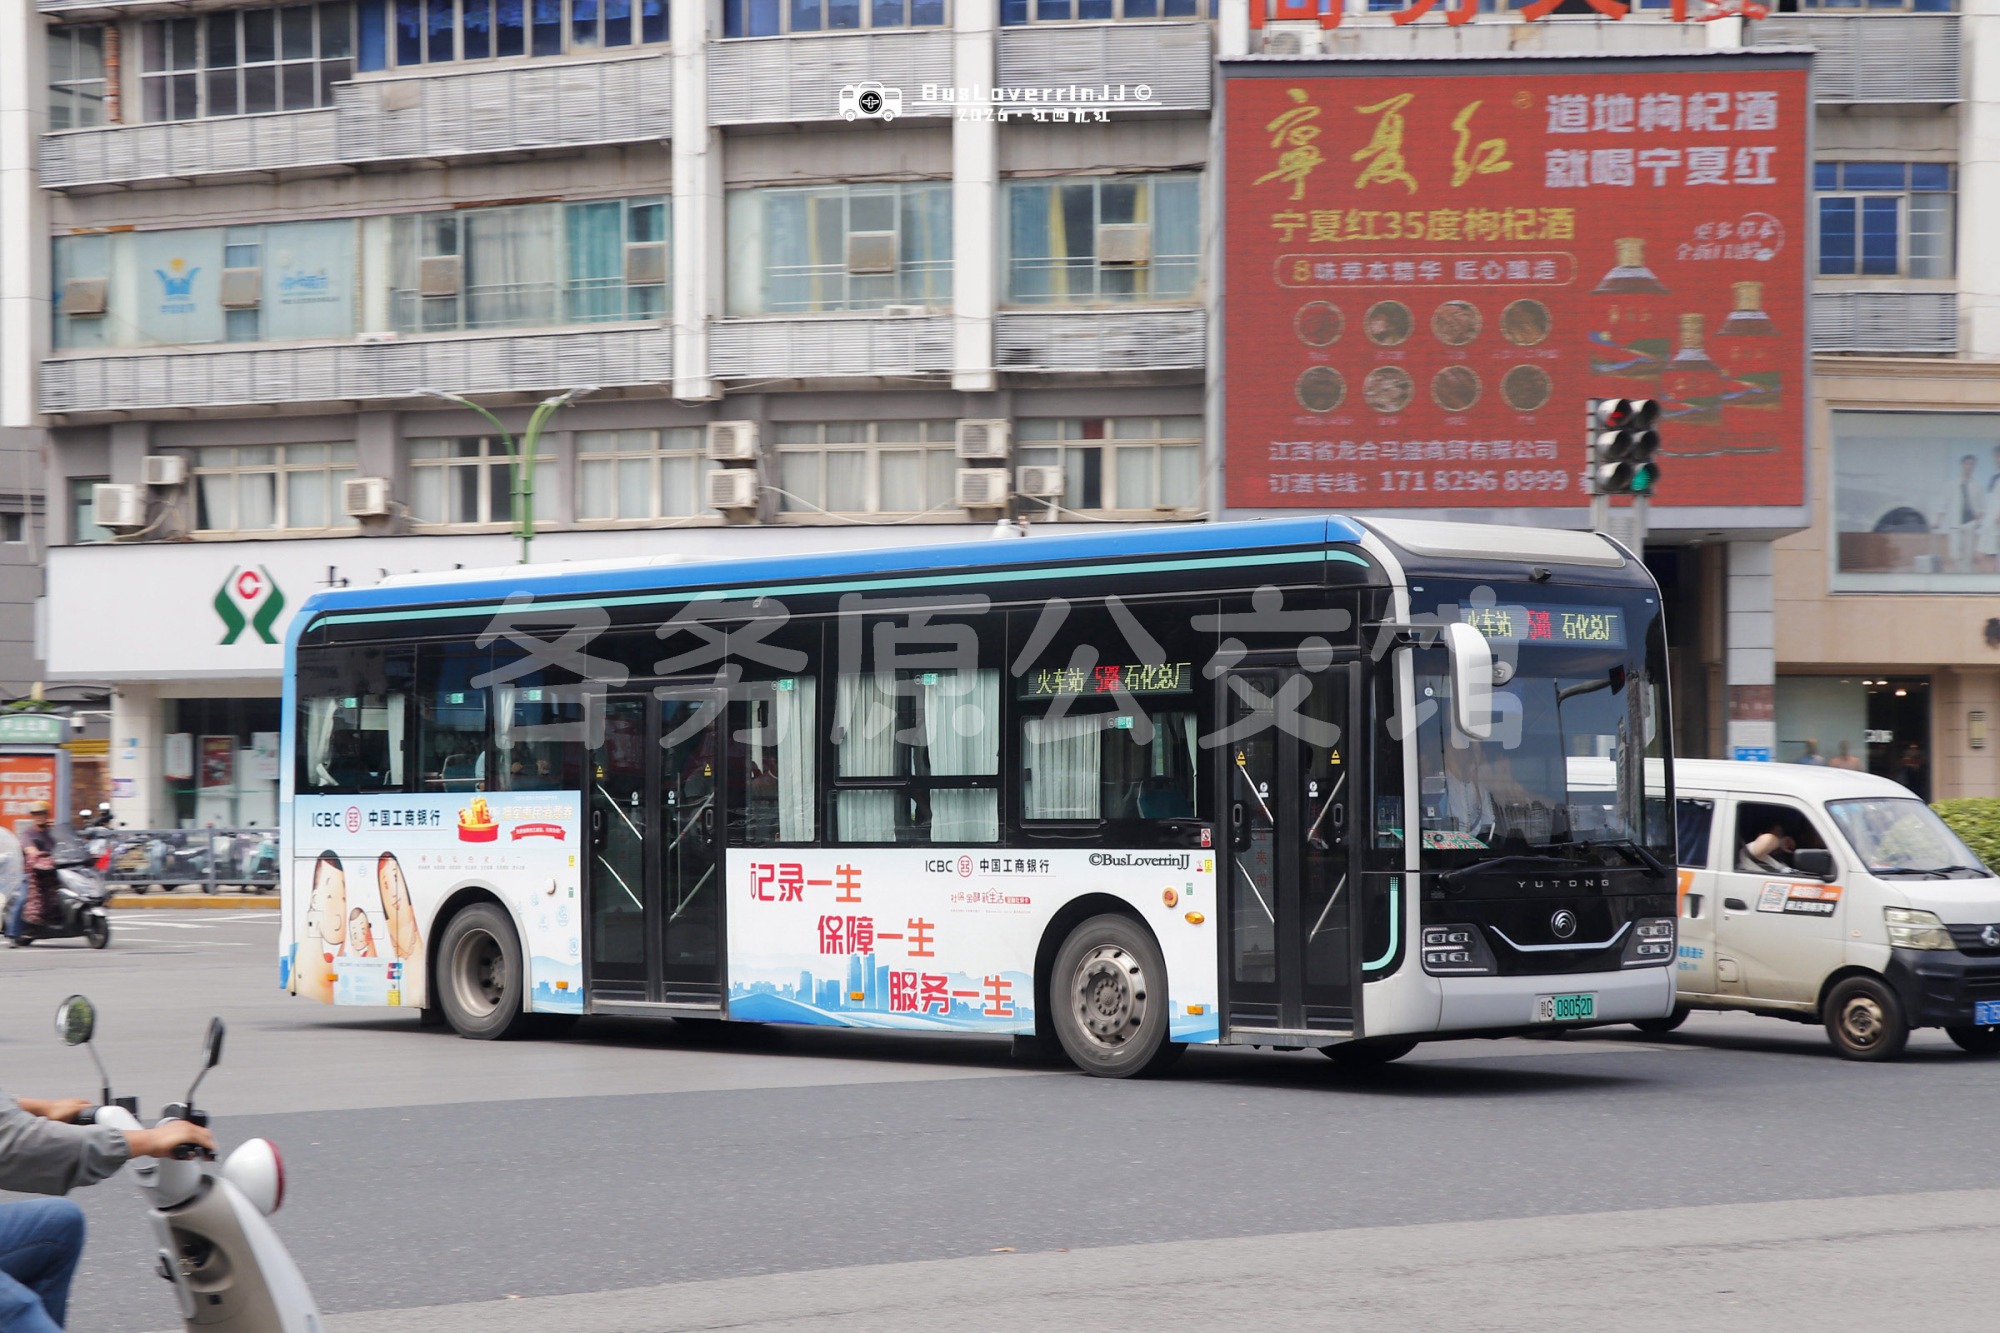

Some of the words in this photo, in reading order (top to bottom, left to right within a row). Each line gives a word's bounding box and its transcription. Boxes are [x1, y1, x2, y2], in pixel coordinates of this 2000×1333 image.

[1546, 91, 1778, 133] 道地枸杞酒
[1545, 146, 1778, 187] 就喝宁夏红
[1271, 207, 1575, 242] 宁夏红35度枸杞酒
[1293, 260, 1443, 281] 8味草本精华
[1454, 260, 1556, 281] 匠心酿造
[1379, 471, 1428, 491] 171
[1433, 470, 1497, 491] 8296
[1503, 469, 1569, 490] 8999
[1561, 613, 1618, 640] 石化总厂
[1036, 667, 1084, 694] 火车站
[1125, 662, 1191, 691] 石化总厂
[312, 812, 341, 827] ICBC
[368, 809, 440, 827] 中国工商银行
[925, 860, 953, 873] ICBC
[979, 858, 1050, 874] 中国工商银行
[750, 862, 862, 903] 记录一生
[1517, 879, 1609, 888] YUTONG
[817, 915, 935, 957] 保障一生
[889, 971, 1013, 1017] 服务一生
